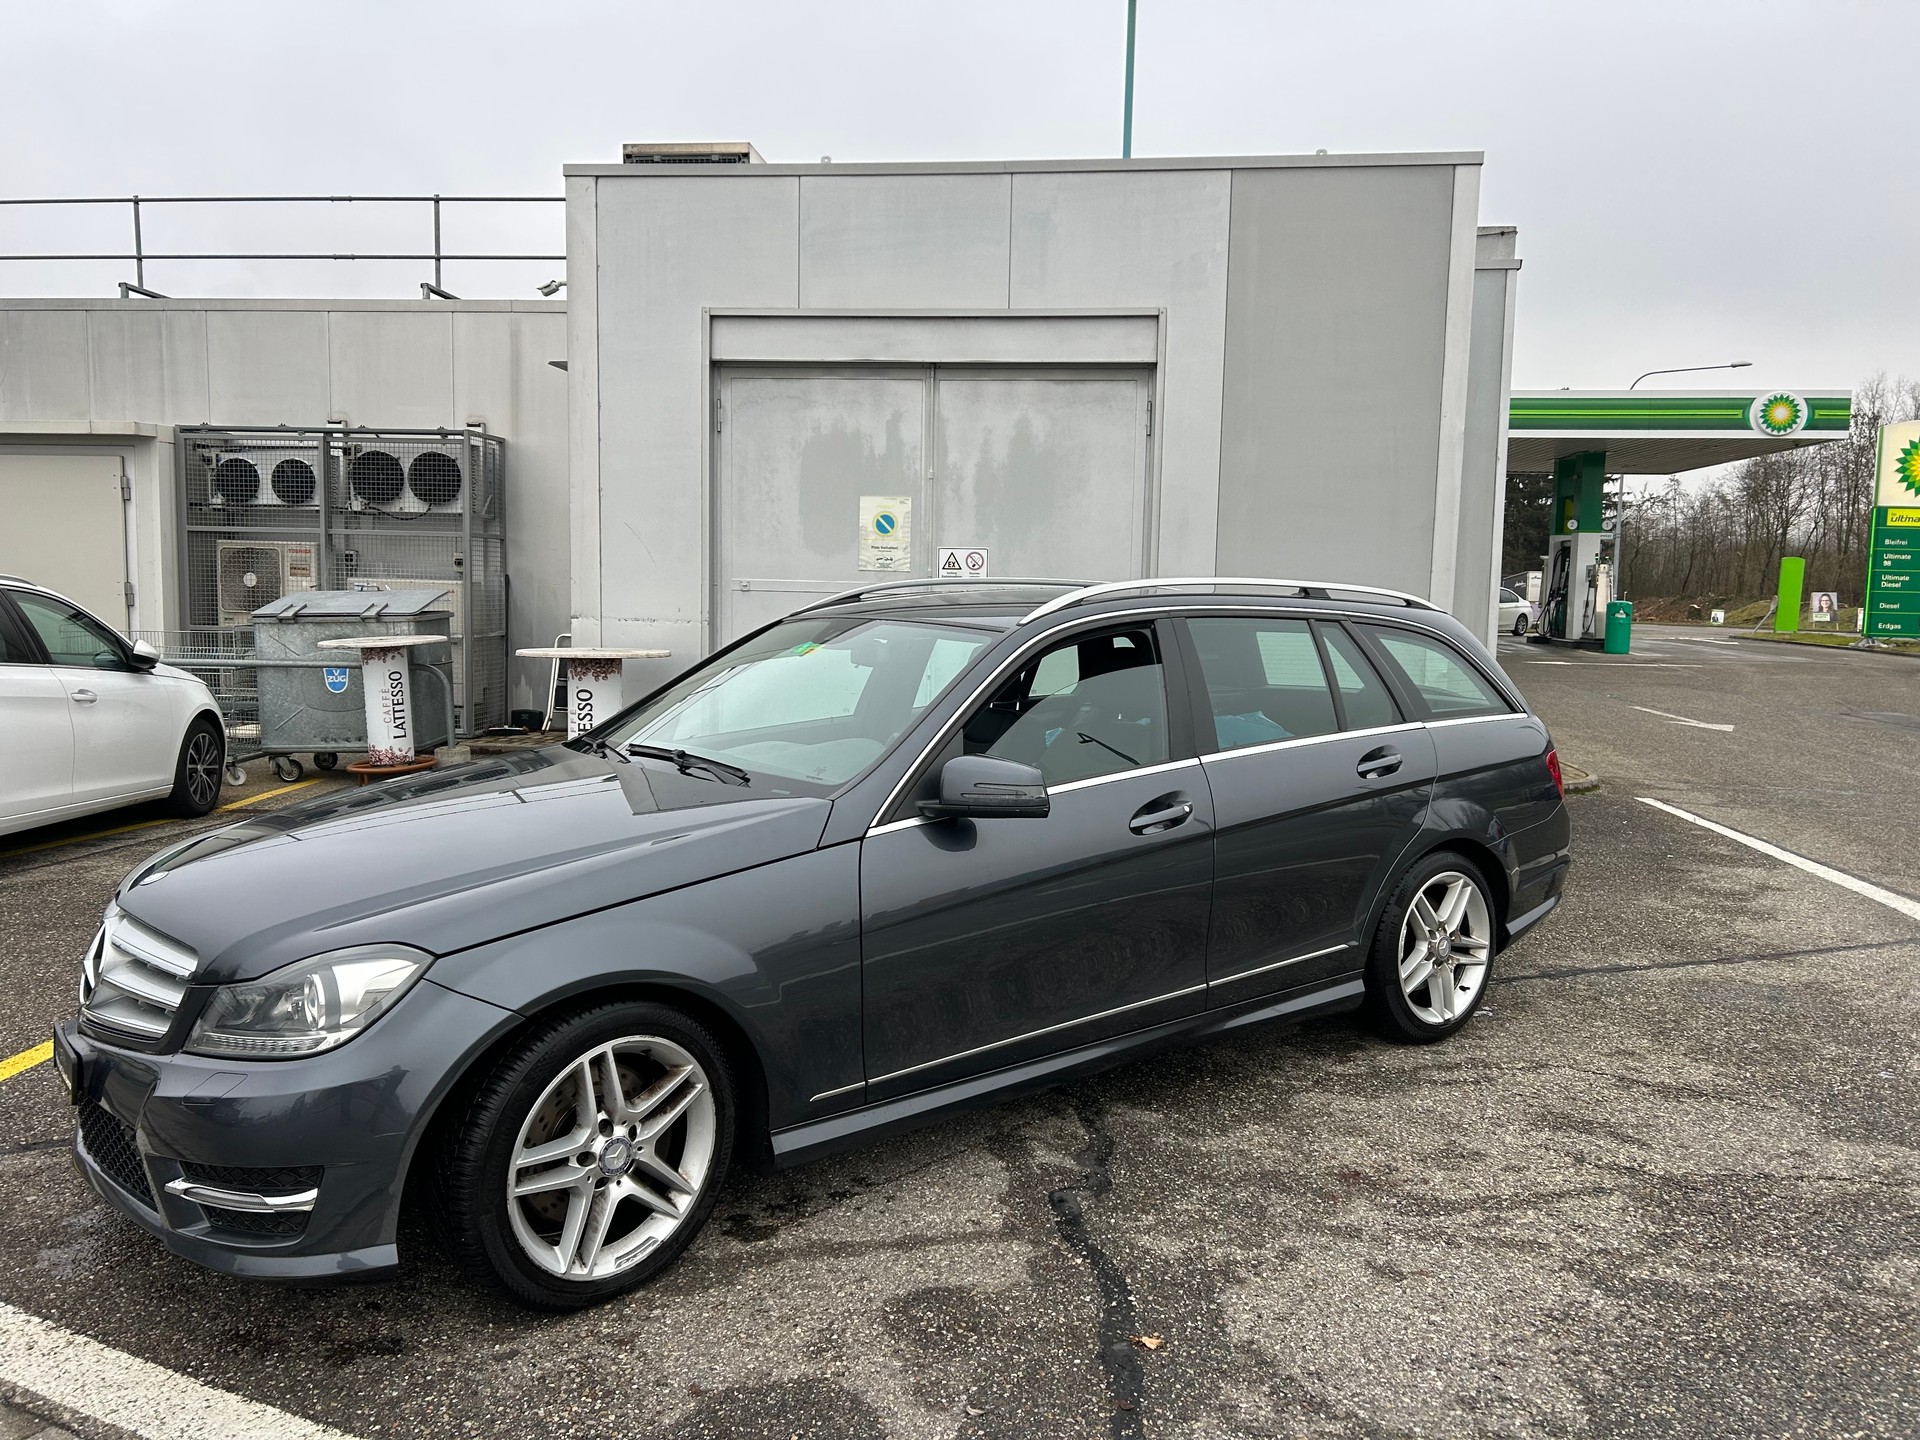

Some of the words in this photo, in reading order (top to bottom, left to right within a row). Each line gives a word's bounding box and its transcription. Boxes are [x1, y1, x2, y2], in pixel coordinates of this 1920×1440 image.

[1884, 538, 1908, 546] Bleifrei
[1878, 622, 1902, 630] Erdgas
[388, 671, 407, 740] LATTESSO
[576, 689, 593, 736] ESSO
